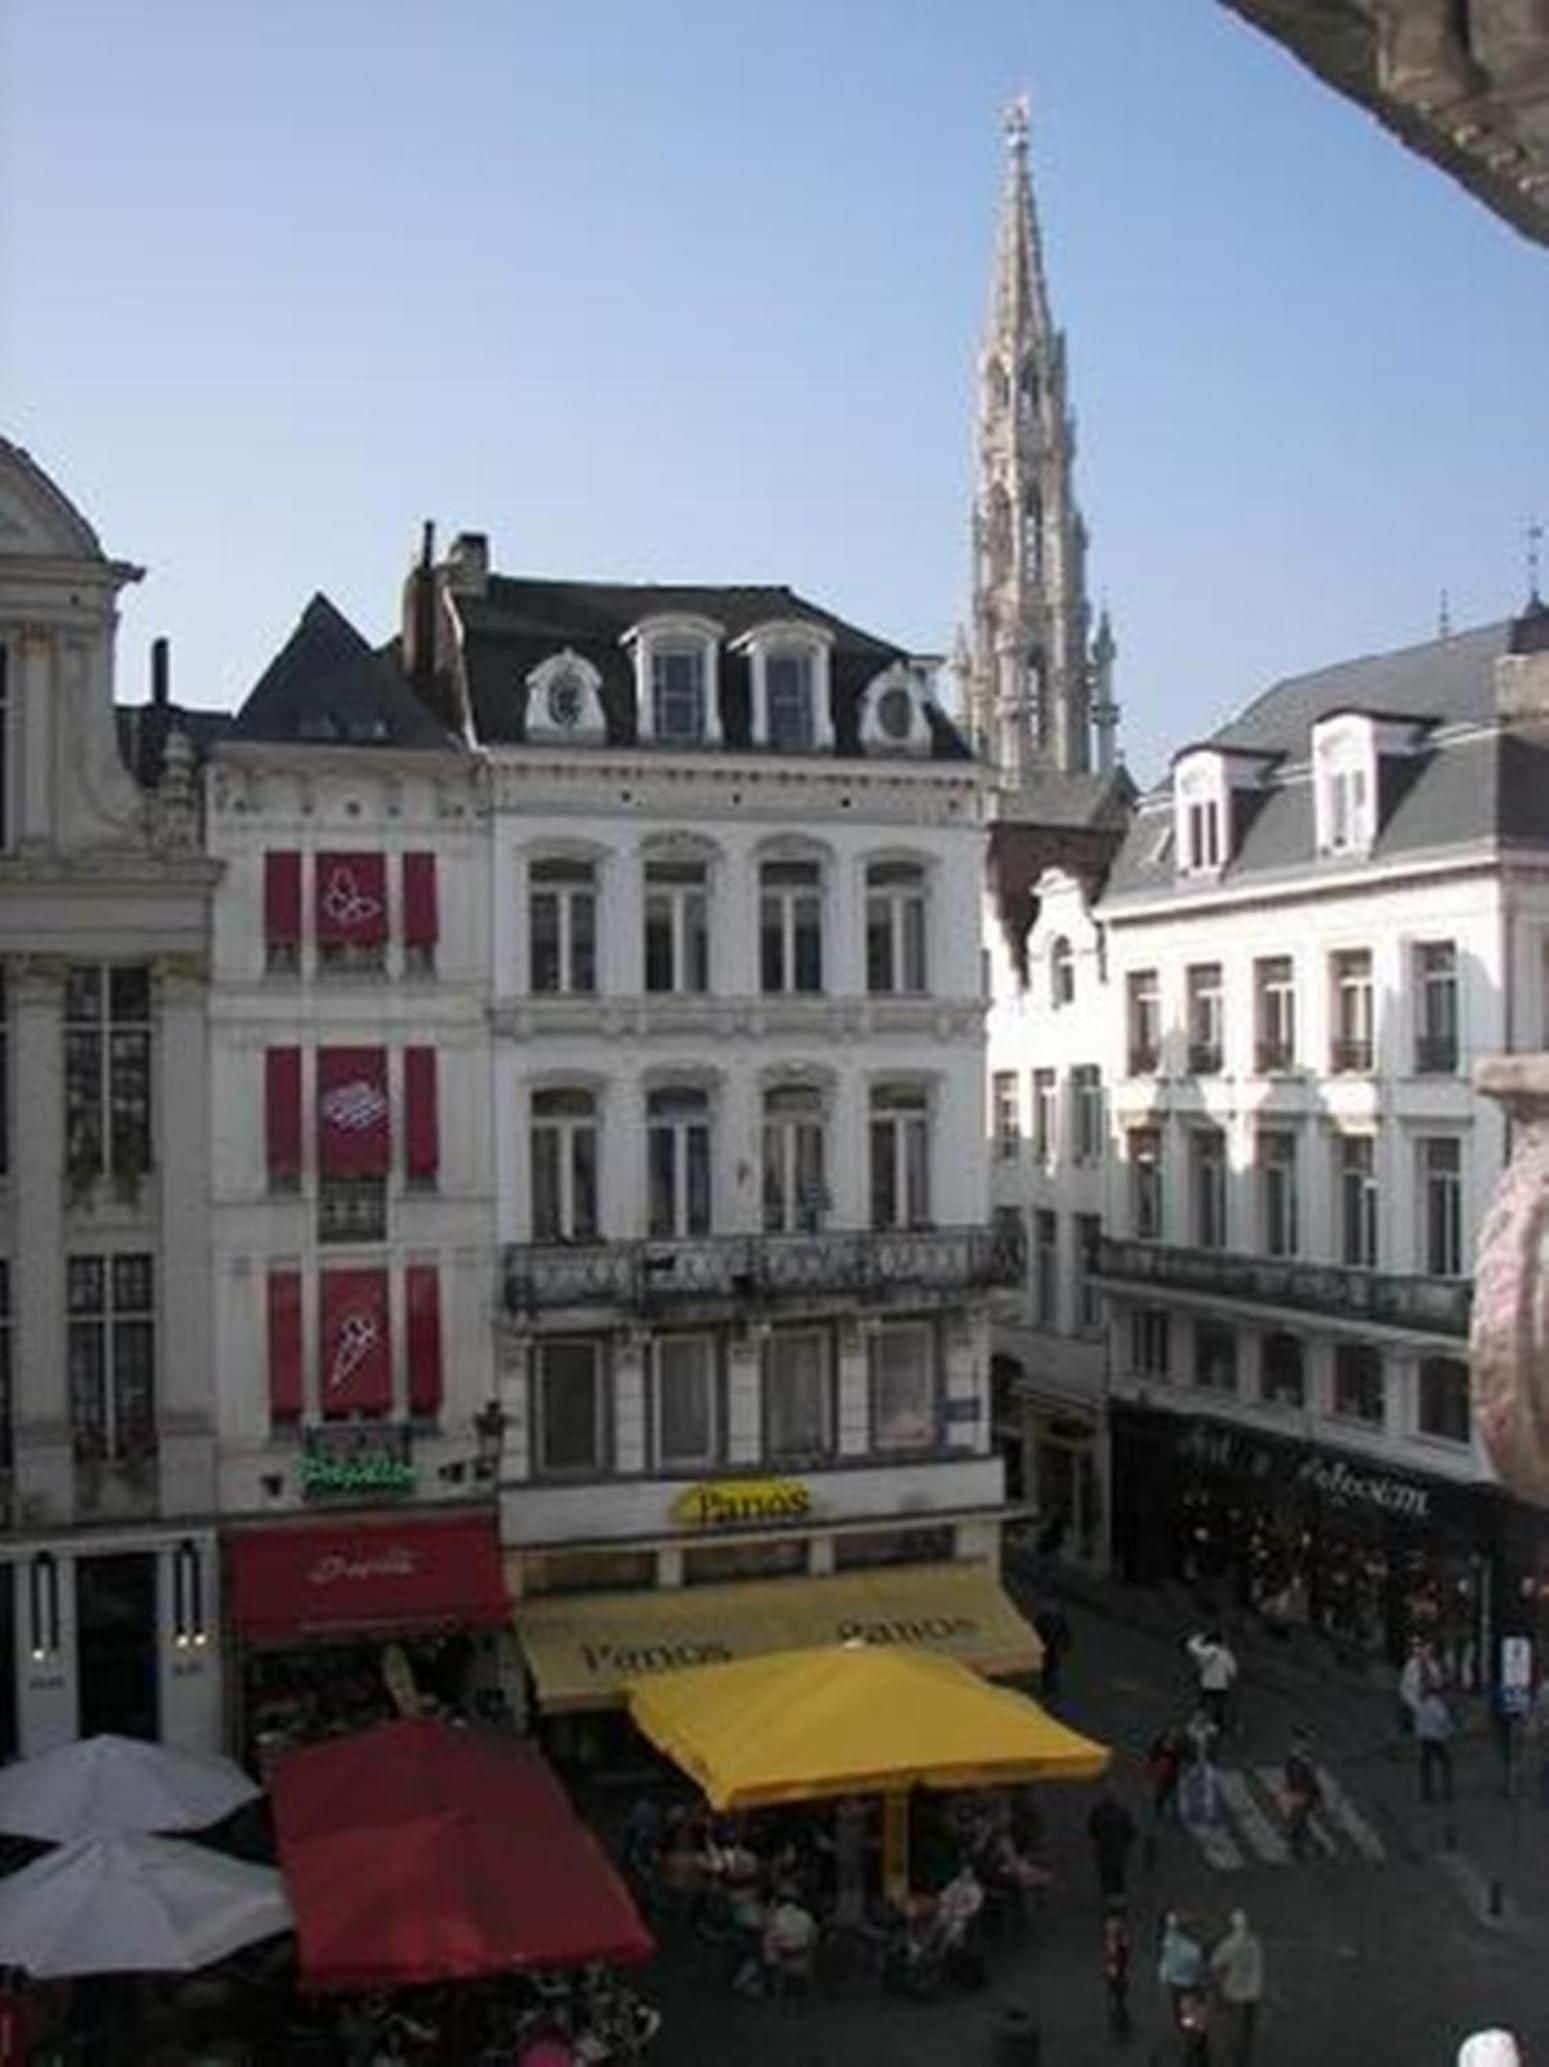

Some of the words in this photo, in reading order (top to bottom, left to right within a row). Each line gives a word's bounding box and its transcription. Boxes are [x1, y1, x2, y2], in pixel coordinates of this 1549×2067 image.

[699, 1481, 810, 1522] Panos
[836, 1614, 980, 1646] Panos
[580, 1639, 735, 1675] Panos
